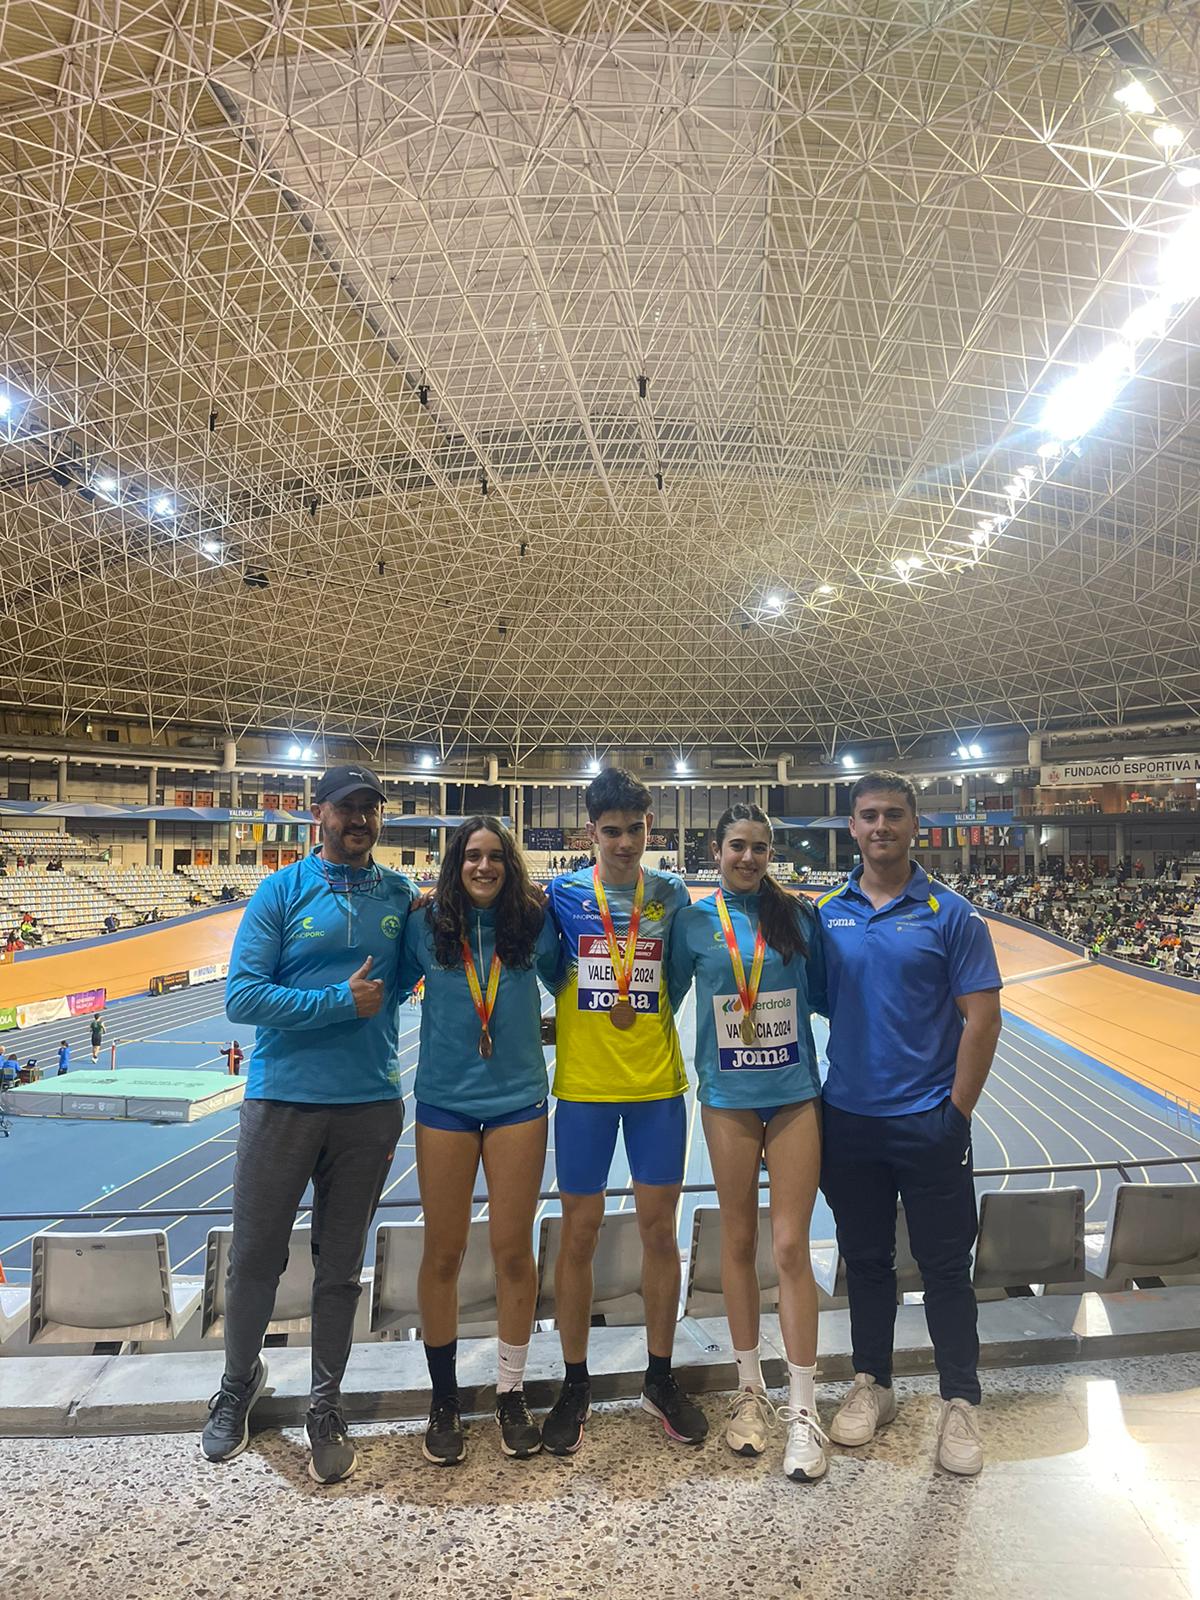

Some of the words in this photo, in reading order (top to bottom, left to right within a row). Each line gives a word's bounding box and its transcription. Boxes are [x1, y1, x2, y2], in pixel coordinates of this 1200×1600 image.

[1064, 762, 1121, 777] FUNDACIÓ
[1124, 760, 1191, 774] ESPORTIVA
[588, 965, 632, 981] VALEN
[634, 967, 654, 983] 2024
[752, 997, 791, 1011] erdrola
[726, 1022, 772, 1039] VACIA
[773, 1020, 791, 1037] 2024
